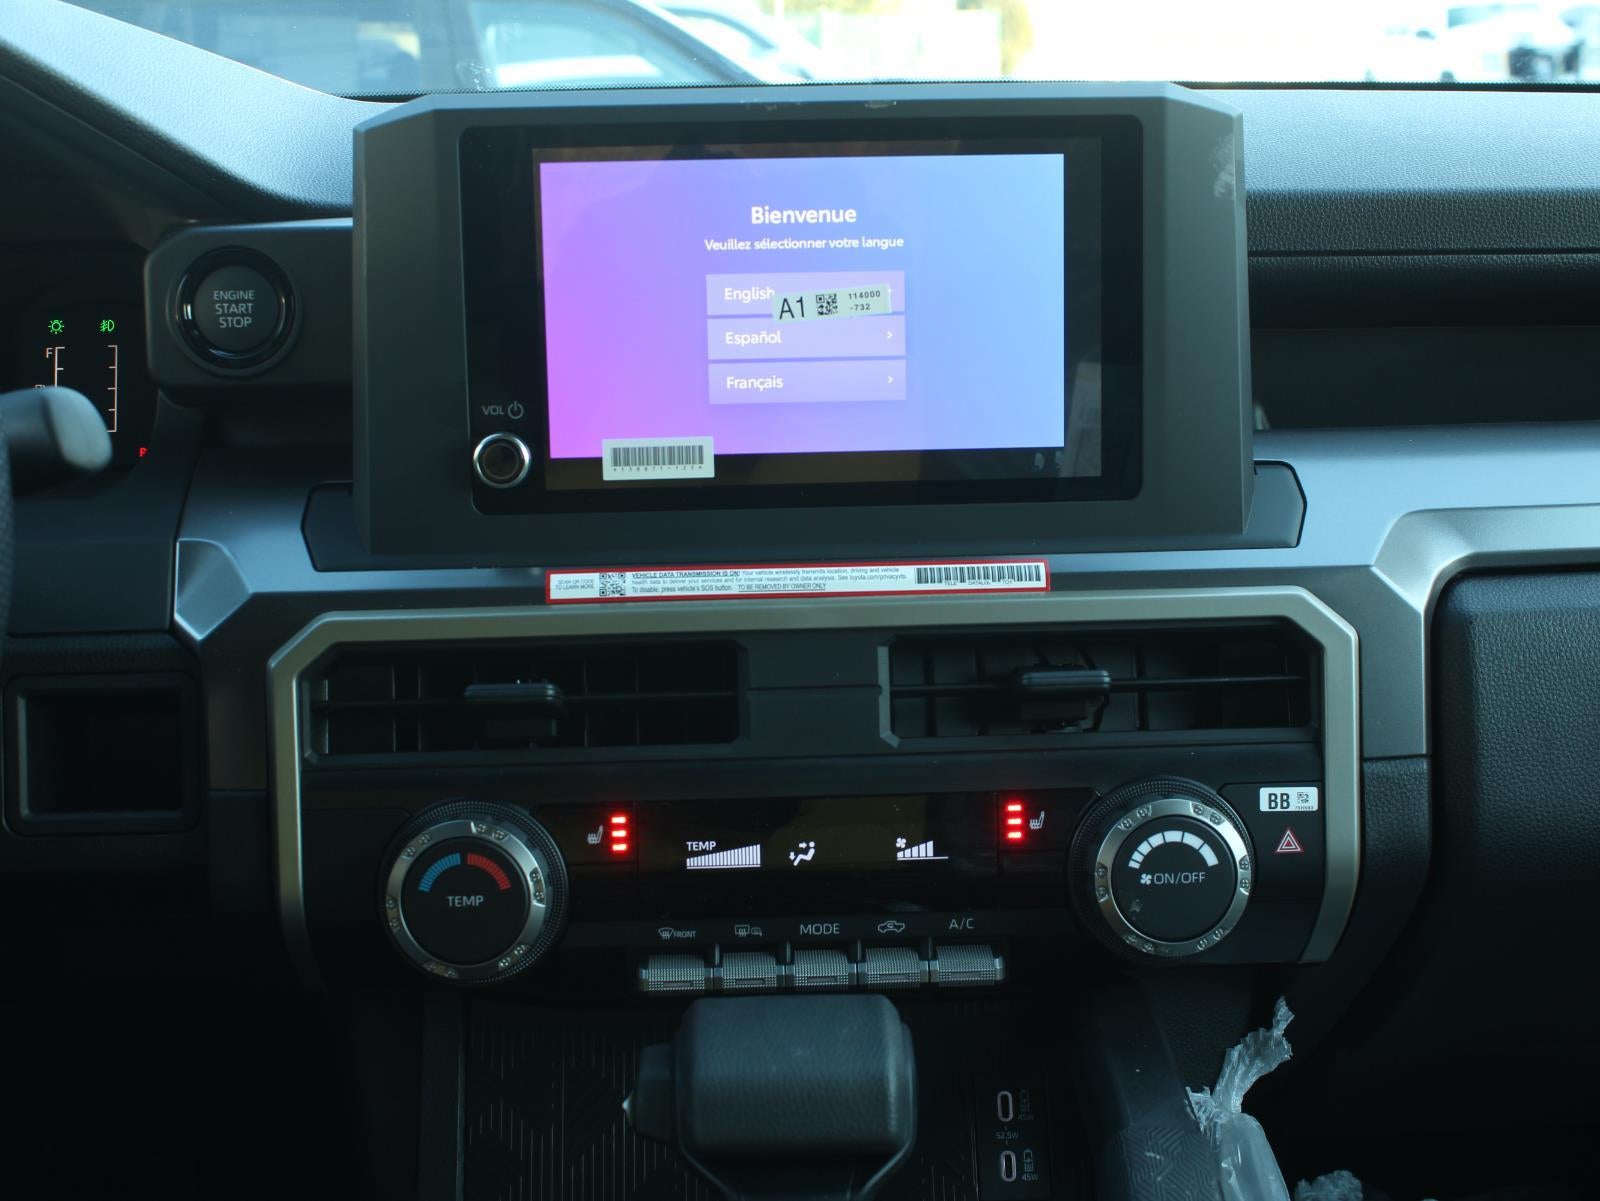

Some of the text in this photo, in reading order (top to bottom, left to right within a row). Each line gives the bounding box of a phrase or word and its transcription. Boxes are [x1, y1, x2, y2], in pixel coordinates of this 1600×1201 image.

[751, 206, 858, 224] Bienvenue
[704, 236, 904, 251] Veuillez sélectionner votre langue
[213, 290, 255, 300] ENGINE
[724, 287, 775, 304] English
[848, 290, 881, 300] 114000
[215, 303, 254, 314] START
[779, 296, 805, 320] A1
[850, 303, 871, 312] -732
[219, 317, 252, 328] STOP
[725, 331, 782, 347] Español
[726, 376, 784, 391] Français
[482, 405, 504, 415] VOL
[1268, 792, 1290, 810] BB
[686, 841, 716, 851] TEMP
[1153, 872, 1205, 885] ON/OFF
[447, 895, 484, 908] TEMP
[800, 923, 840, 935] MODE
[949, 918, 975, 930] A/C
[673, 930, 696, 939] FRONT
[1021, 1173, 1039, 1182] 45W
